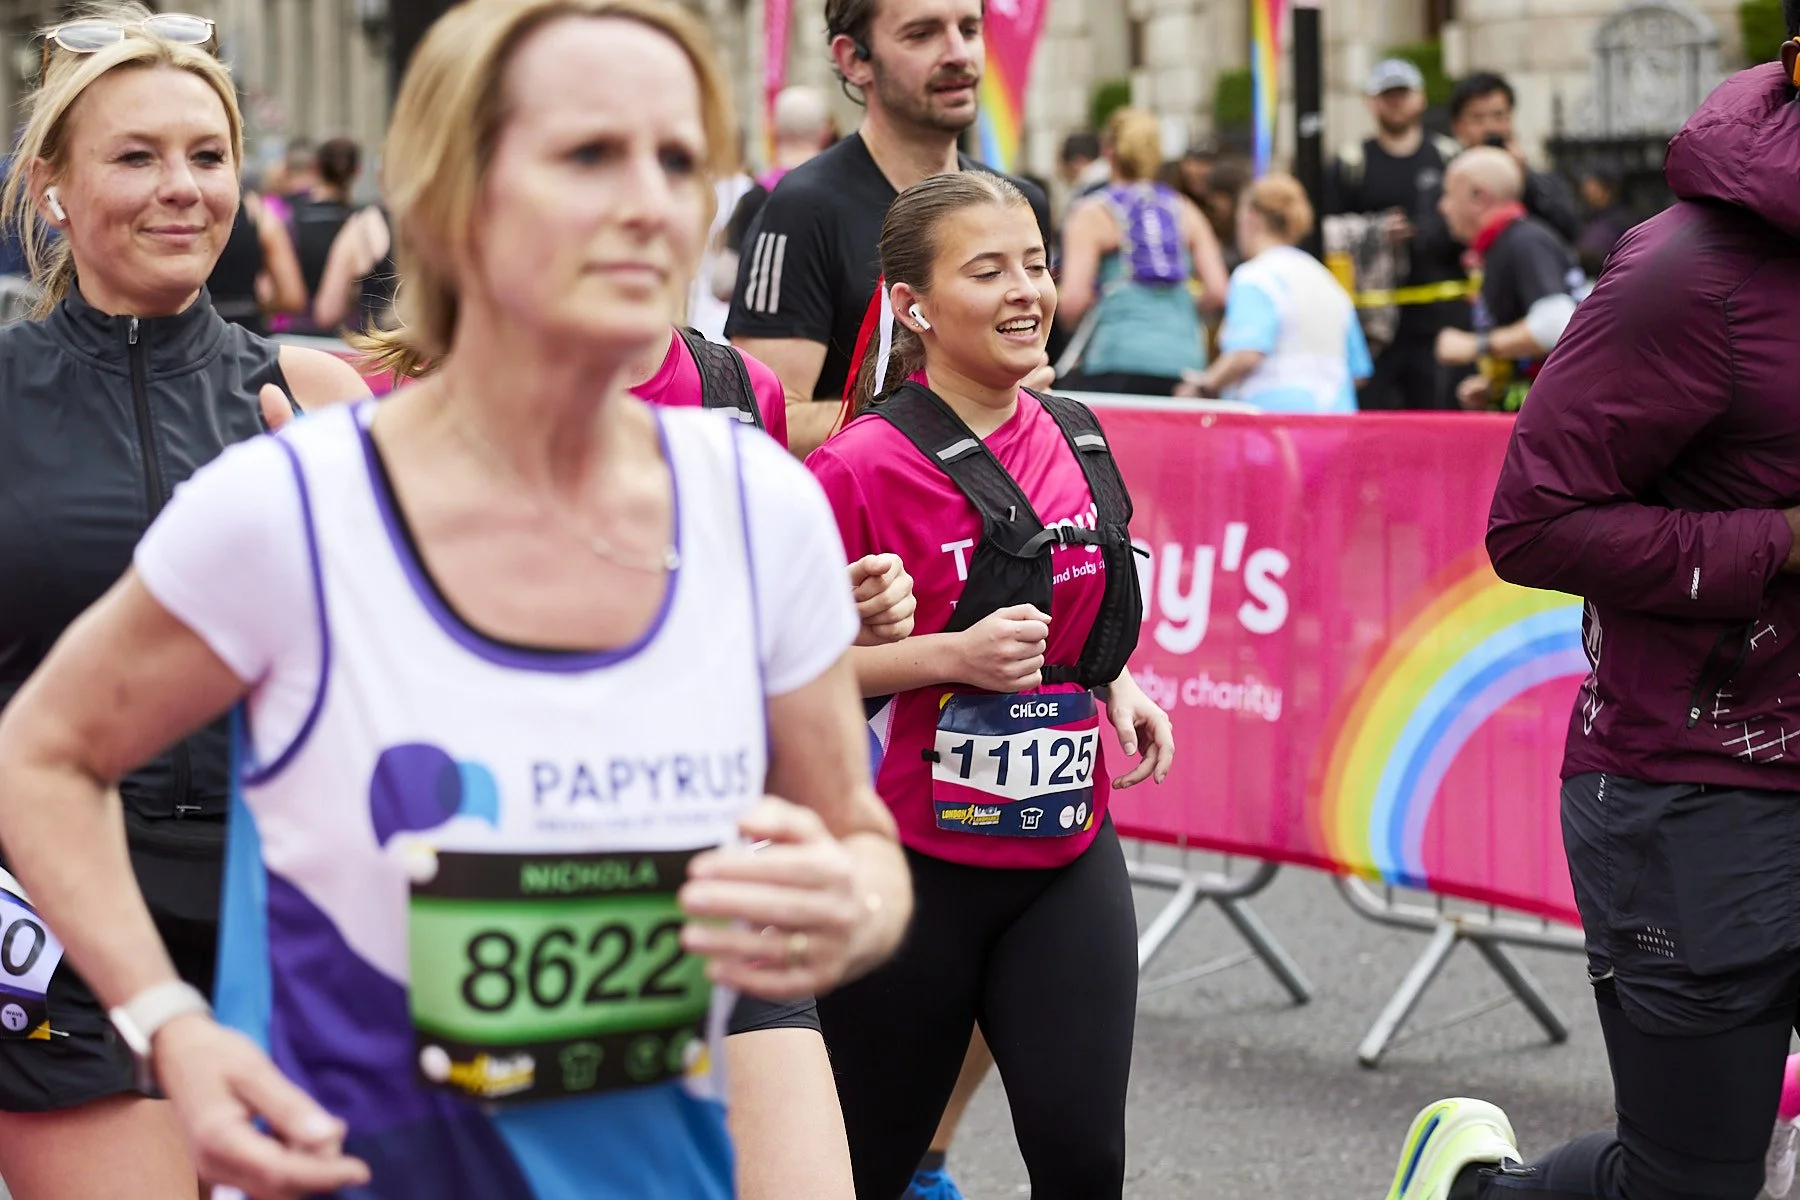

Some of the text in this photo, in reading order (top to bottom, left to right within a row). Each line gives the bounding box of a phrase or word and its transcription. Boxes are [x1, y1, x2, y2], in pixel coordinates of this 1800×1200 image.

[1072, 561, 1097, 578] baby
[1010, 702, 1059, 719] CHLOE
[1182, 671, 1283, 722] charity
[531, 747, 752, 805] PAPYRUS
[951, 734, 1093, 786] 11125
[520, 857, 658, 893] NICHOLA
[0, 918, 46, 977] 0
[462, 917, 688, 1012] 8622
[5, 1009, 23, 1018] WAVE
[12, 1016, 18, 1028] 1
